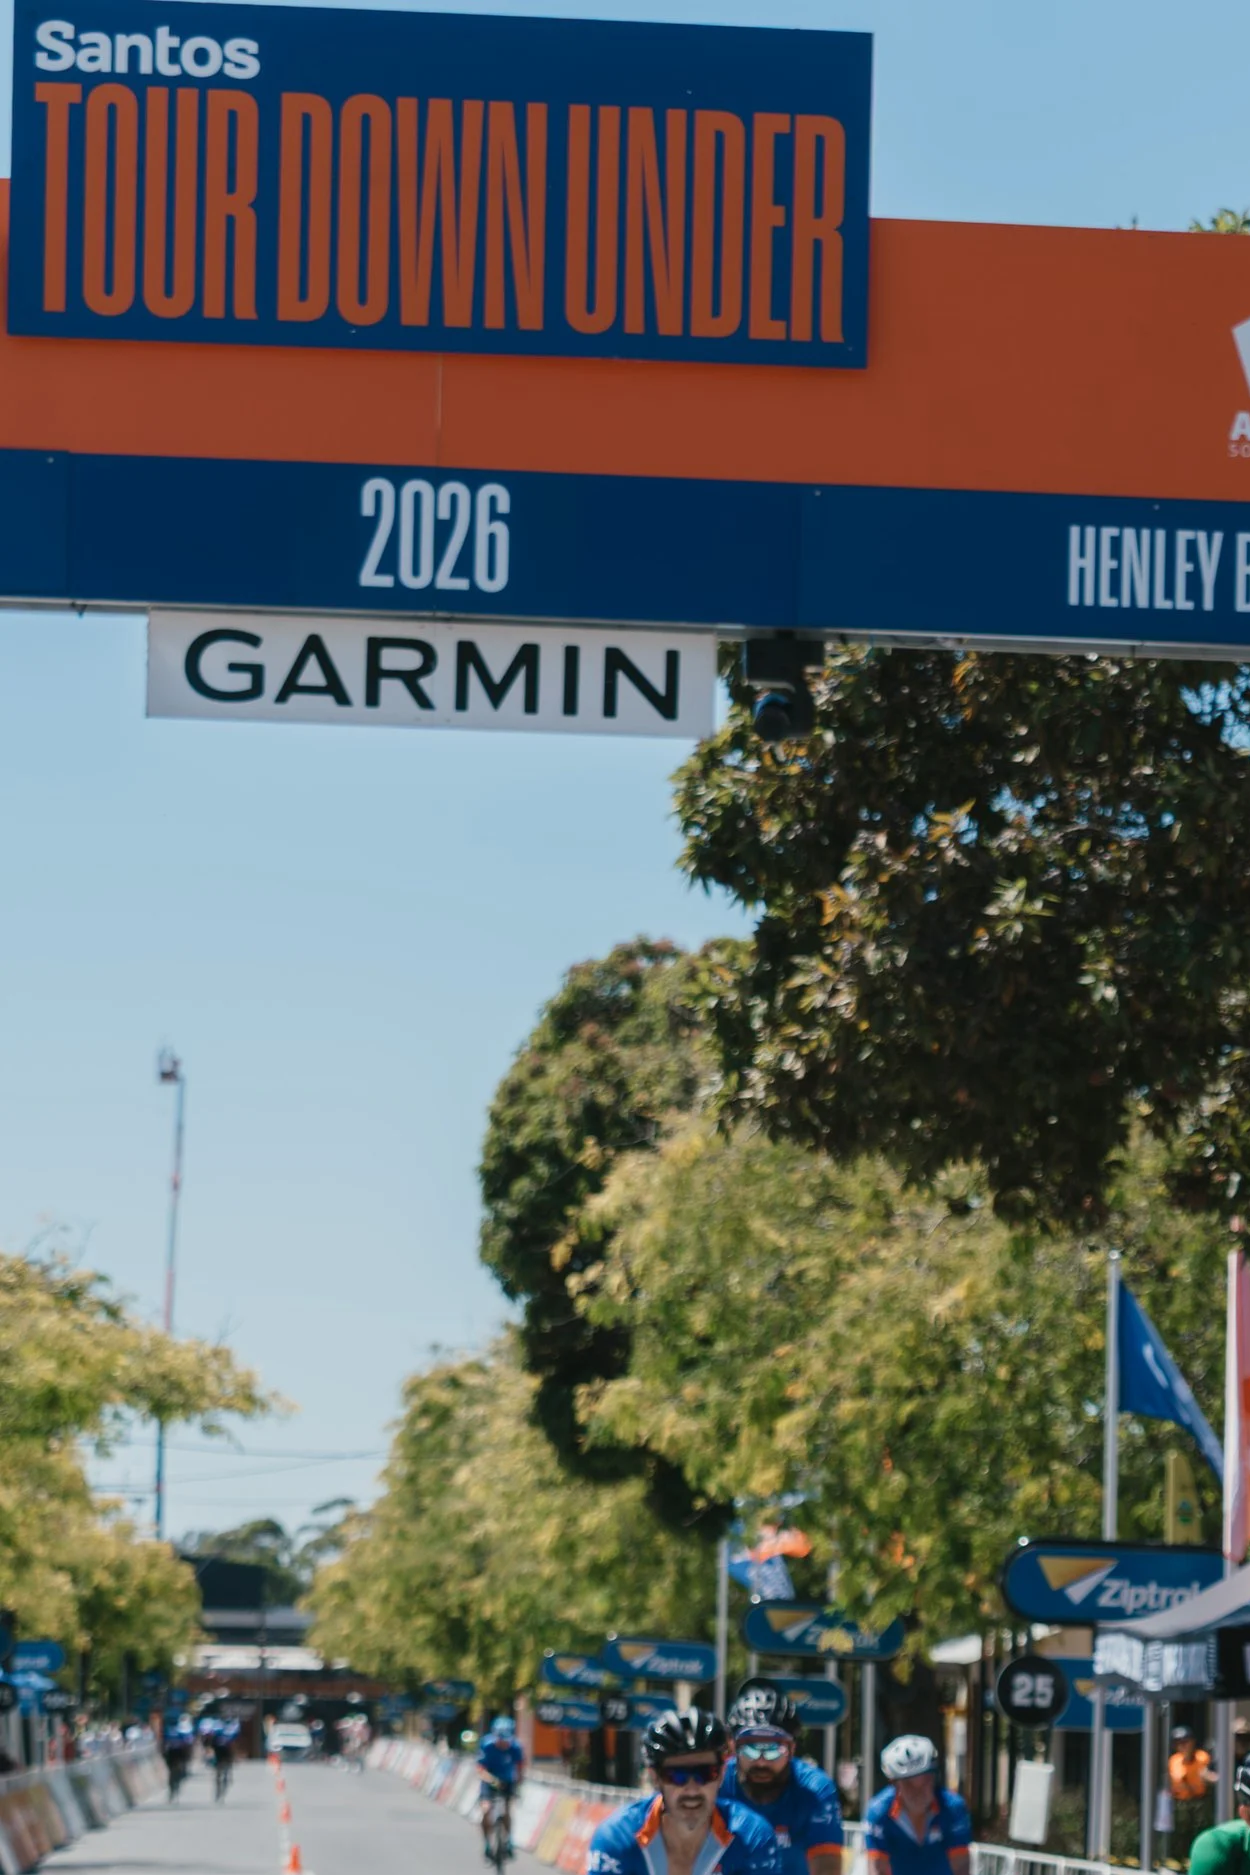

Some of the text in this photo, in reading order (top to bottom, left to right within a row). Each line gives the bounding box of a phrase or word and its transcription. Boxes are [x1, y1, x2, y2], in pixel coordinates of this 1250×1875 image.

[34, 20, 261, 80] Santos
[34, 81, 846, 344] TOUR DOWN UNDER
[359, 477, 511, 593] 2026
[1068, 524, 1223, 610] HENLEY
[183, 628, 680, 722] GARMIN
[1011, 1673, 1054, 1709] 25
